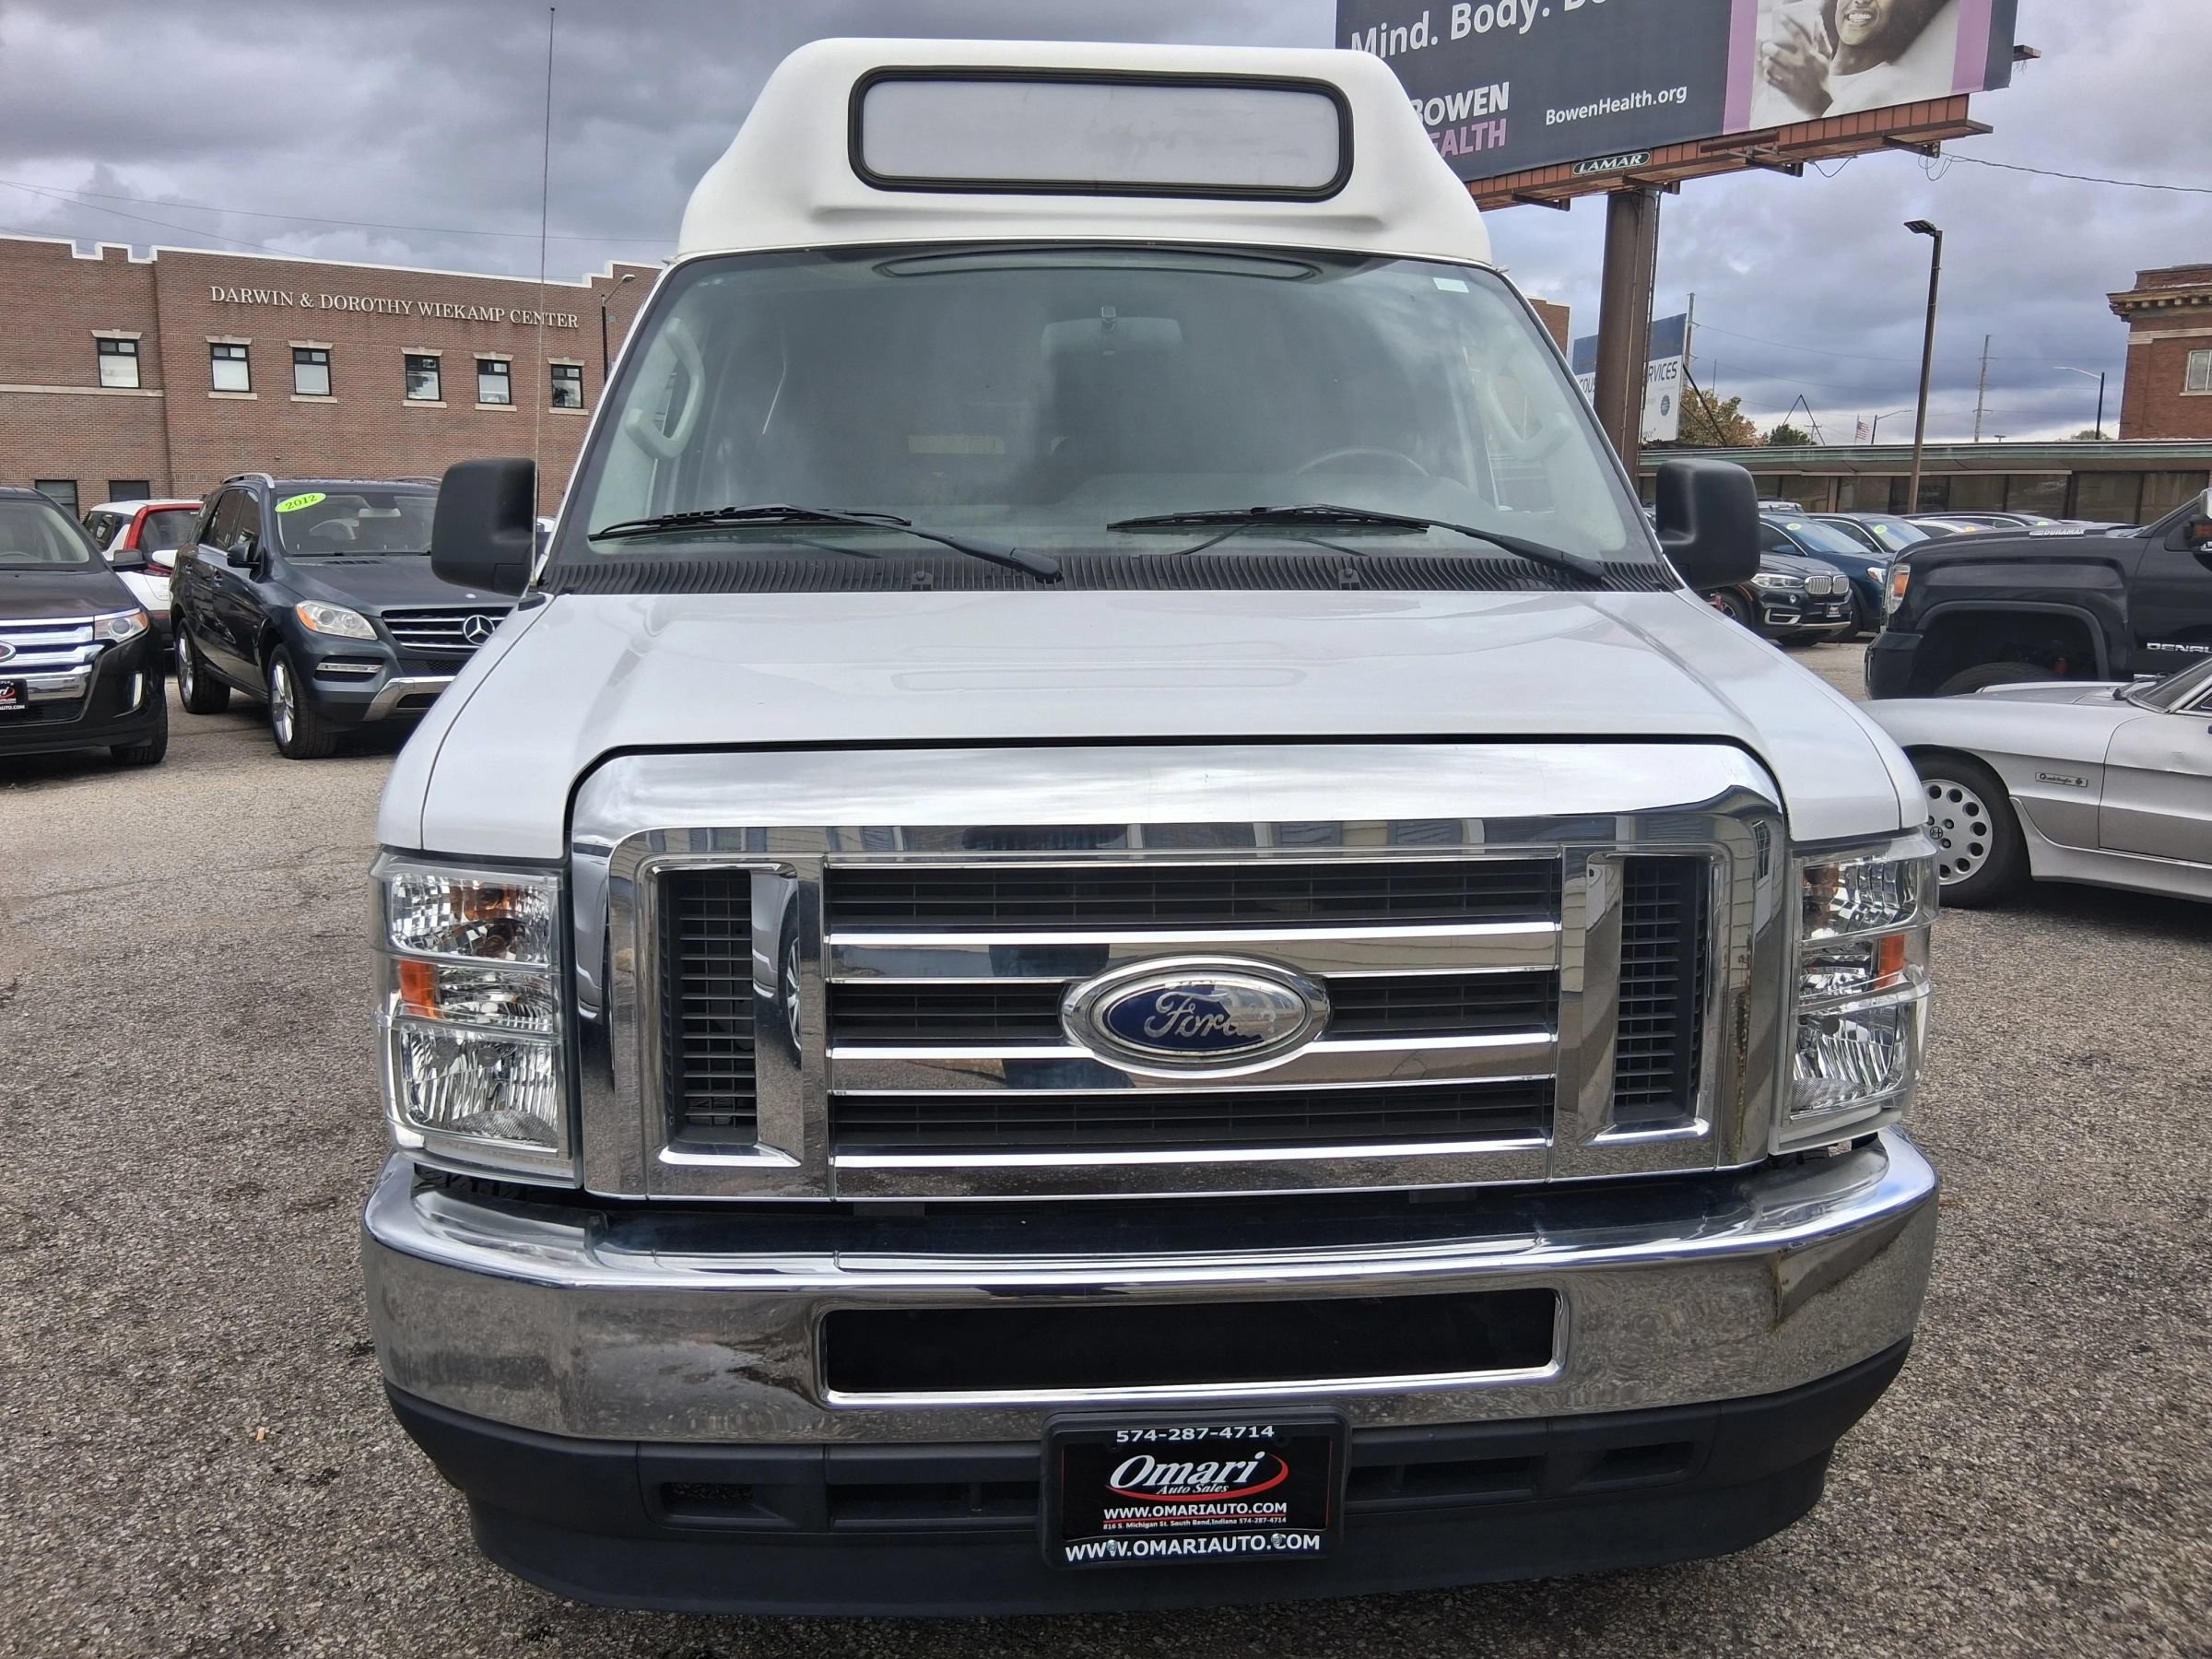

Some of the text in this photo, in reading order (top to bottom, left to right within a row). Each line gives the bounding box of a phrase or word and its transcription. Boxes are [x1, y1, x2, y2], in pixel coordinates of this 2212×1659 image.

[1351, 0, 1550, 58] Mind. Body.
[1546, 86, 1688, 125] BowenHealth.org
[1428, 118, 1507, 158] EALTH
[1578, 154, 1642, 173] LAMAR
[210, 286, 579, 328] DARWIN & DOROTHY WIEKAMP CENTER
[1648, 360, 1678, 383] RVICES
[285, 494, 318, 511] 2012
[2147, 642, 2212, 653] DENAL
[1116, 1425, 1275, 1443] 574-287-4714
[1110, 1451, 1265, 1488] Omari
[1156, 1483, 1230, 1495] Auto Sales
[1103, 1502, 1288, 1520] WWW.OMARIAUTO.COM
[1126, 1521, 1158, 1529] Michigan
[1065, 1534, 1320, 1562] WWW.OMARIAUTO.COM
